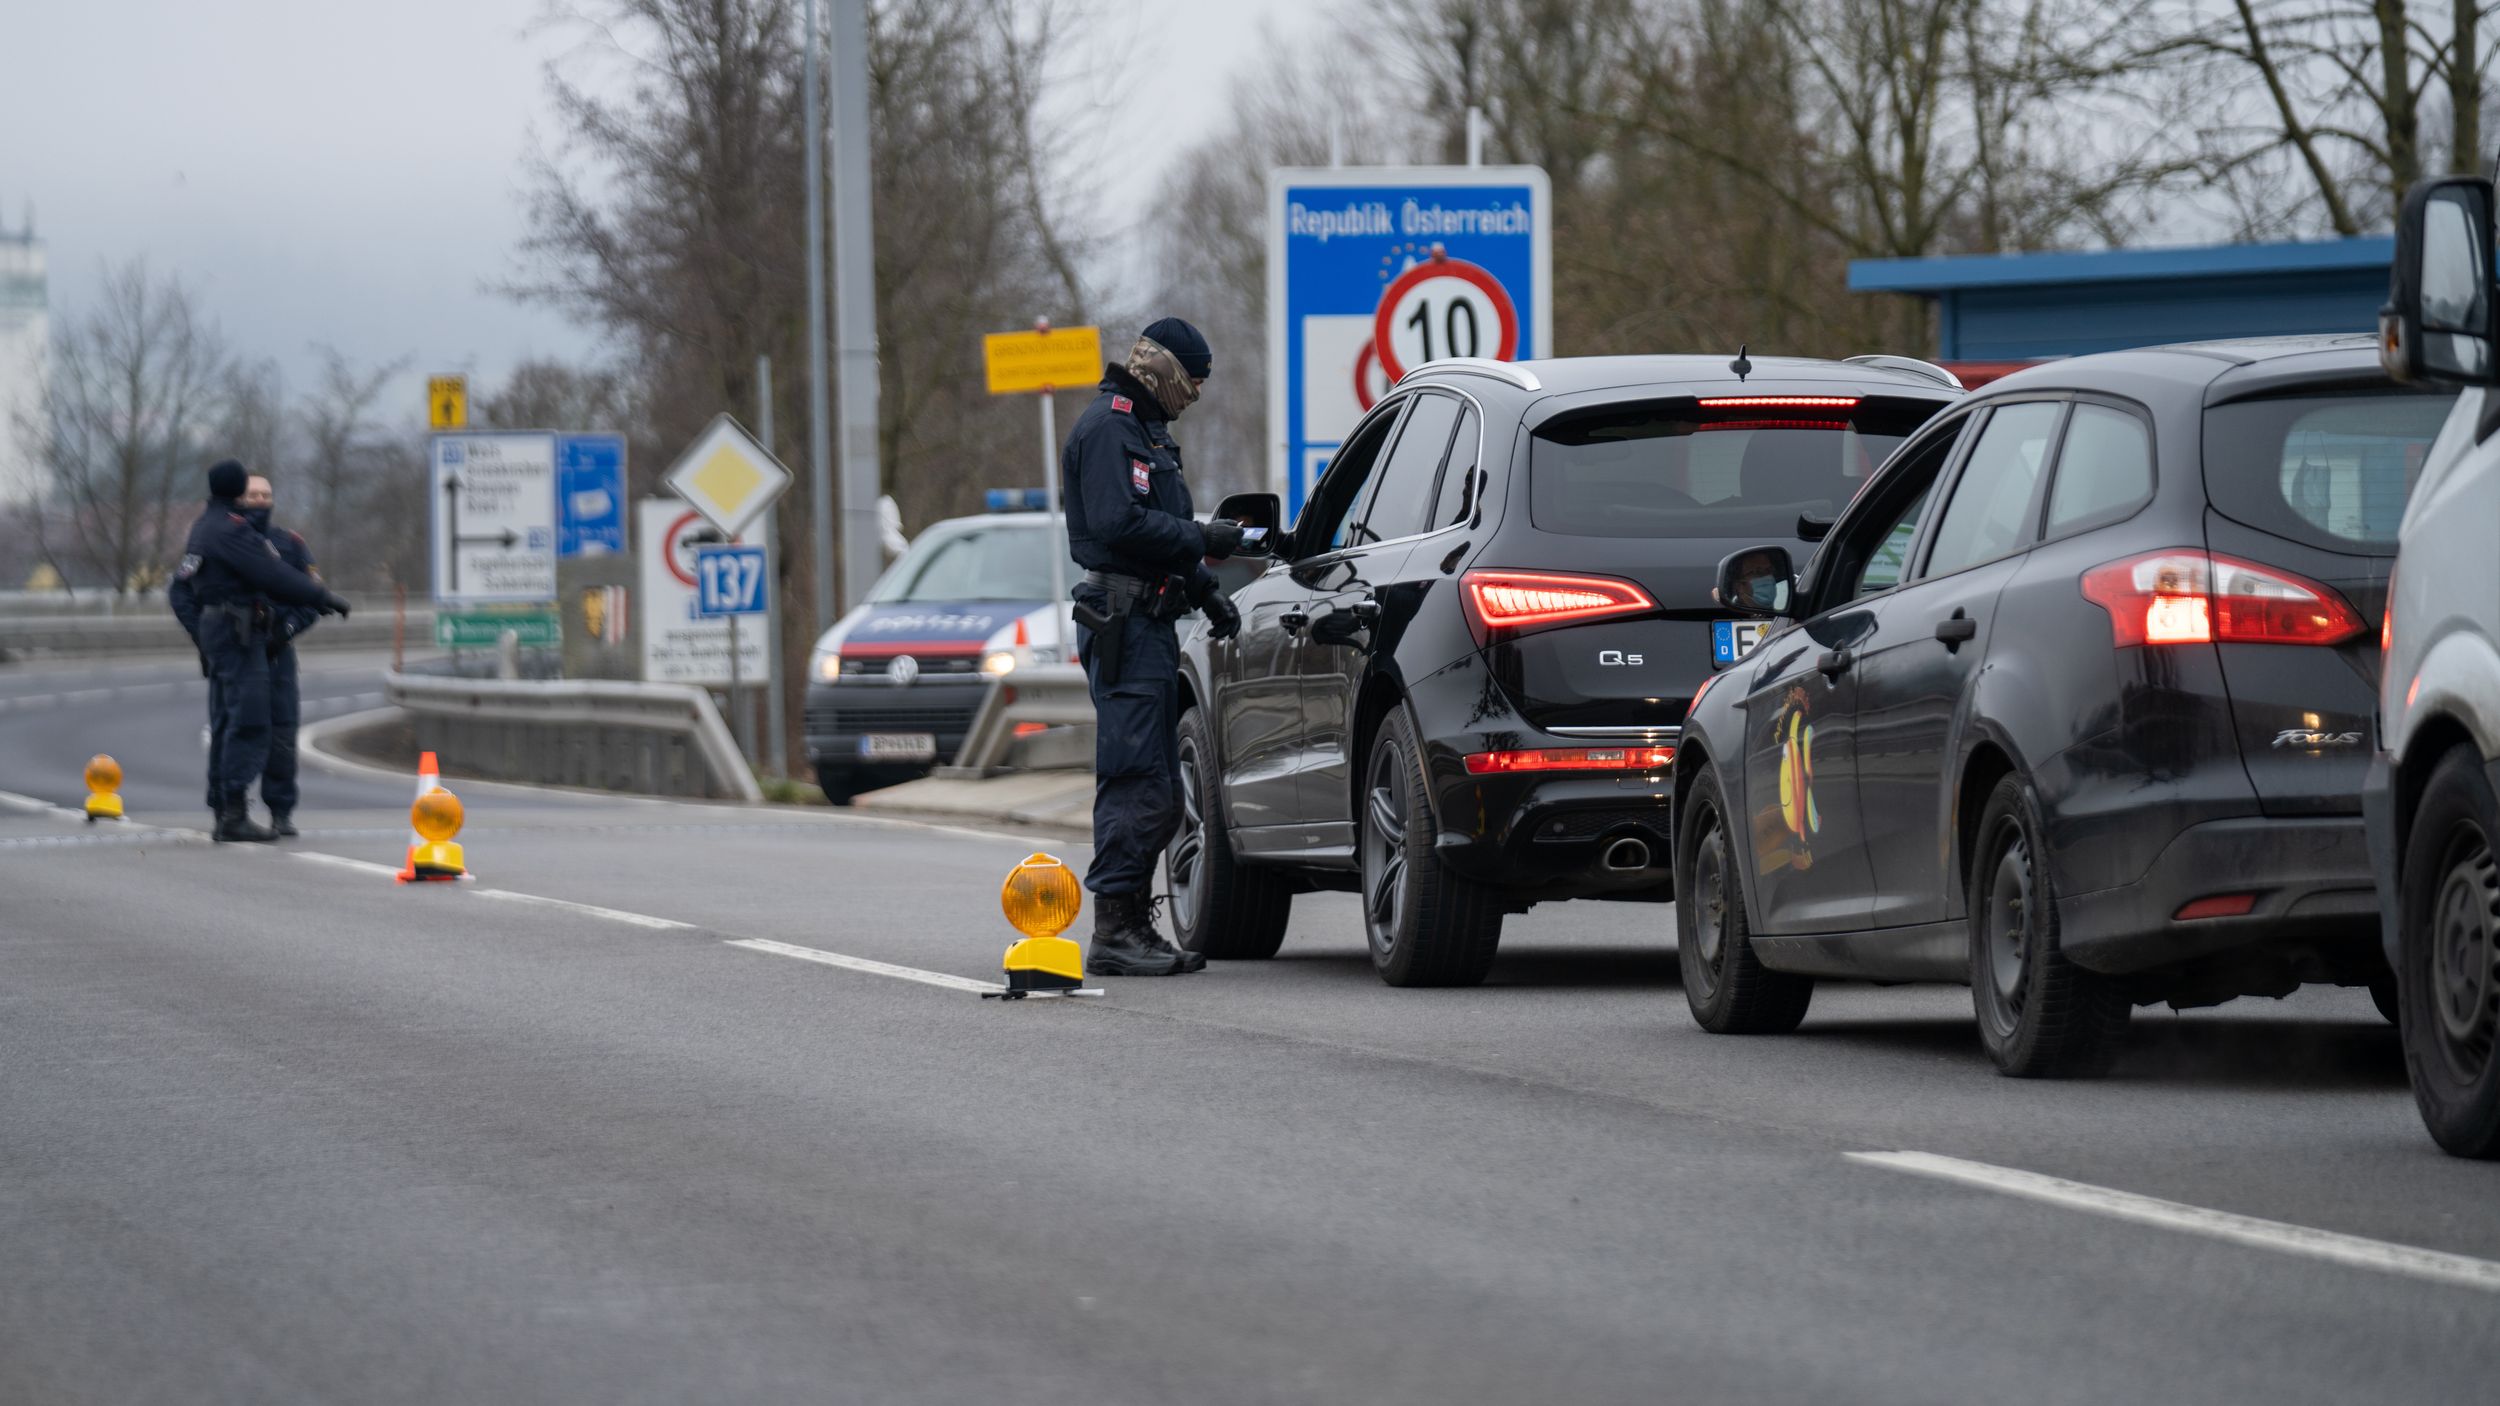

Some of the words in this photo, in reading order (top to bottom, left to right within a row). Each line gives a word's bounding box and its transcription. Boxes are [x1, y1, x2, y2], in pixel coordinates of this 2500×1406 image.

[1290, 203, 1393, 243] Republik
[1402, 198, 1529, 234] Österreich
[1409, 297, 1478, 363] 10
[702, 554, 762, 607] 137
[1599, 650, 1643, 665] Q5
[1721, 645, 1729, 655] D
[1736, 626, 1755, 656] F
